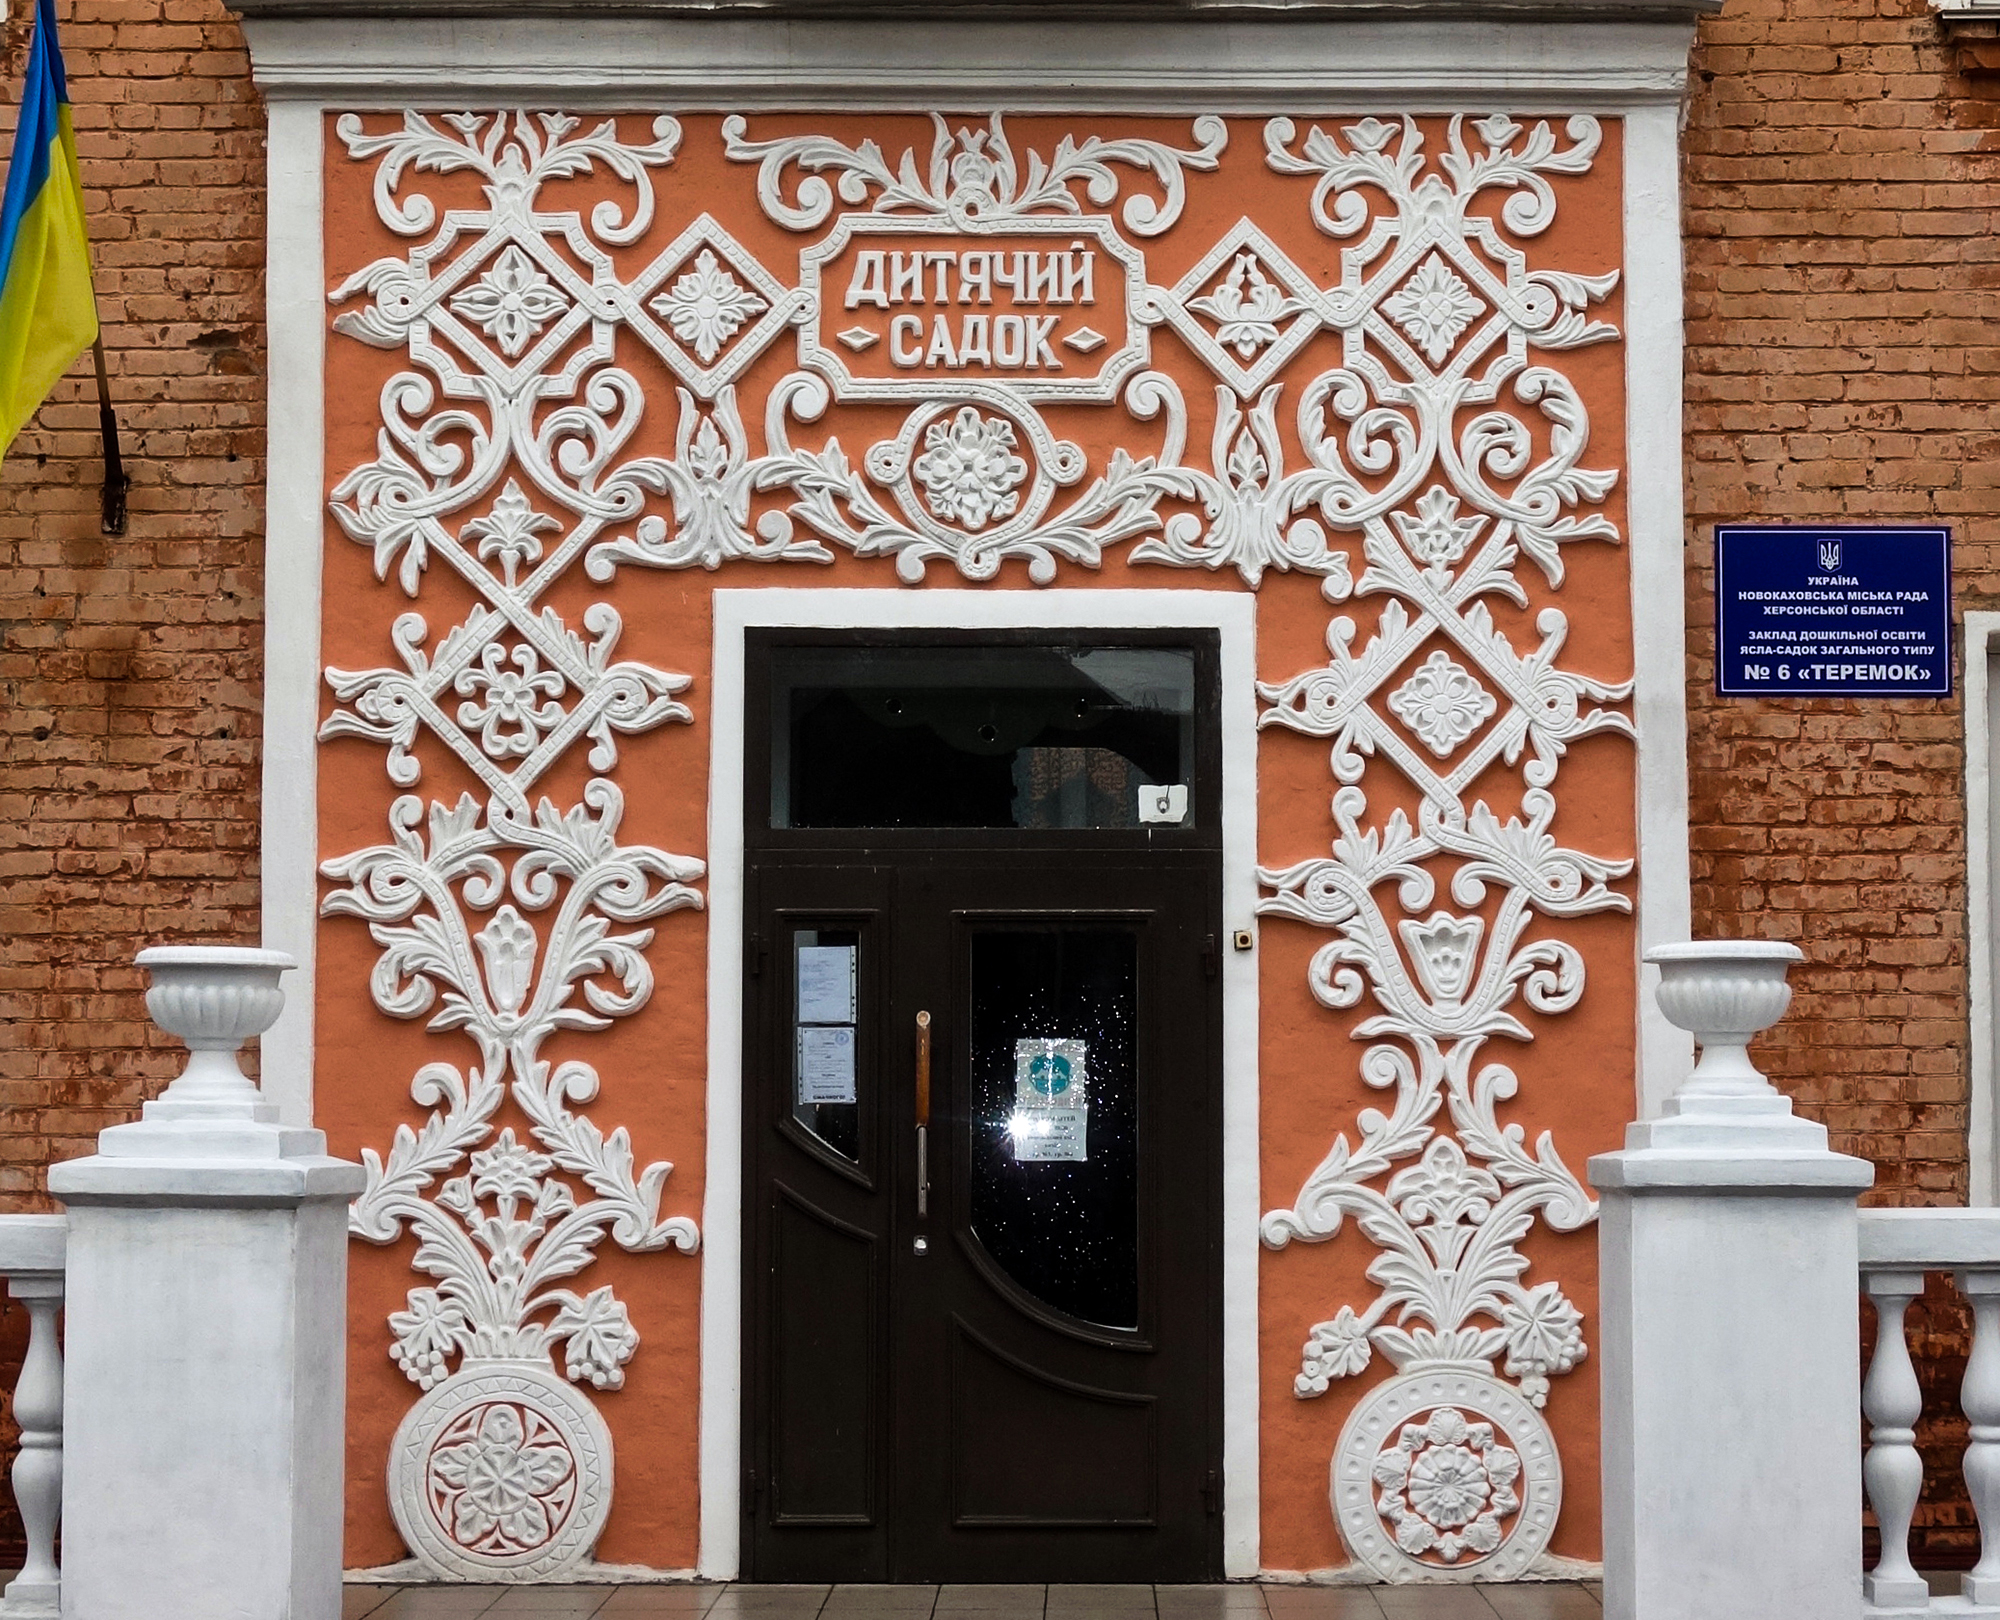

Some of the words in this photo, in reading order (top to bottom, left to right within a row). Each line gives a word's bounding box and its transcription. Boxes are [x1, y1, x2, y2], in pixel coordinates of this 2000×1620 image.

[844, 241, 1096, 309] ДИТЯЧИЙ
[890, 314, 1063, 369] САДОК
[1807, 575, 1859, 586] УКРАЇНА
[1738, 591, 1845, 601] НОВОКАХОВСЬКА
[1847, 591, 1893, 601] МІСЬКА
[1896, 591, 1929, 602] РАДА
[1763, 604, 1848, 615] ХЕРСОНСЬКОЇ
[1851, 606, 1904, 615] ОБЛАСТІ
[1748, 631, 1797, 641] ЗАКЛАД
[1799, 629, 1878, 641] ДОШКІЛЬНОЇ
[1881, 631, 1926, 640] ОСВІТИ
[1740, 645, 1818, 656] ЯСЛА-САДОК
[1820, 645, 1900, 655] ЗАГАЛЬНОГО
[1902, 645, 1935, 655] ТИПУ
[1744, 664, 1770, 680] №
[1777, 664, 1791, 680] 6
[1798, 664, 1931, 680] «ТЕРЕМОК»
